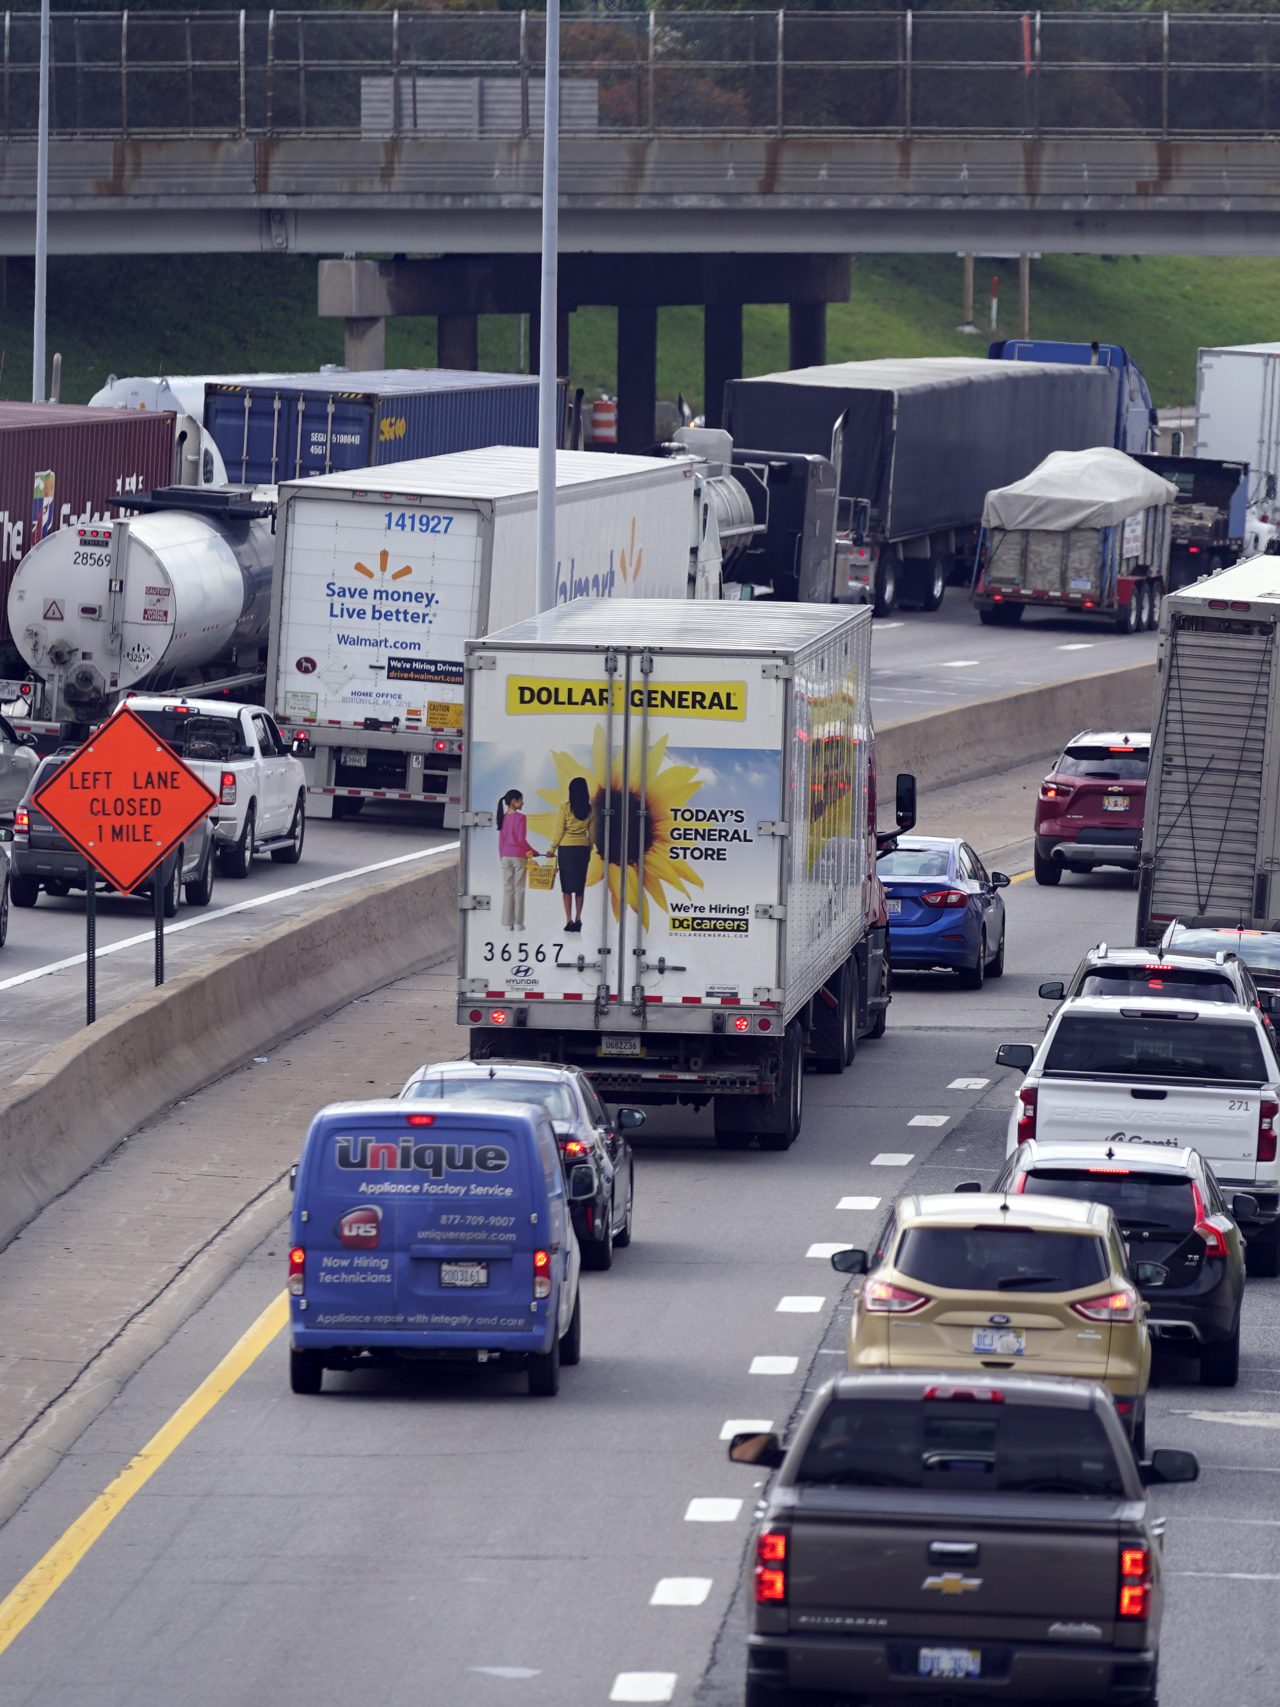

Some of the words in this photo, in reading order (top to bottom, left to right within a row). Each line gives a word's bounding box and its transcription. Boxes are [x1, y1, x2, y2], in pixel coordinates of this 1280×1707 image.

[311, 432, 327, 442] SEGU
[310, 445, 326, 455] 45G1
[384, 511, 454, 535] 141927
[73, 551, 111, 567] 28569
[555, 549, 616, 606] almart
[146, 588, 170, 596] CAUTION
[326, 581, 369, 600] Save
[373, 588, 440, 609] money.
[329, 603, 367, 620] Live
[371, 604, 434, 624] better.
[337, 633, 422, 651] Walmart.com
[129, 653, 147, 663] 3257
[390, 659, 411, 669] We're
[412, 661, 435, 673] Hiring
[437, 664, 464, 674] Drivers
[389, 671, 463, 683] drive4walmart.com
[376, 692, 403, 700] OFFICE
[518, 685, 614, 707] DOLLAR
[630, 689, 738, 711] GENERAL
[69, 772, 112, 790] LEFT
[133, 771, 180, 789] LANE
[90, 798, 162, 816] CLOSED
[670, 808, 745, 823] TODAY'S
[98, 825, 103, 842] 1
[111, 825, 153, 842] MILE
[669, 827, 753, 843] GENERAL
[669, 847, 728, 861] STORE
[670, 903, 705, 914] We're
[708, 903, 750, 917] Hiring!
[671, 918, 691, 931] DG
[692, 918, 748, 931] careers
[483, 942, 564, 964] 36567
[1229, 1100, 1250, 1111] 271
[1052, 1105, 1243, 1129] CHEVROLET
[335, 1137, 510, 1179] Unique
[359, 1182, 420, 1194] Appliance
[423, 1183, 466, 1195] Factory
[470, 1184, 513, 1196] Service
[440, 1215, 516, 1227] 877-709-9007
[417, 1229, 516, 1242] uniquerepair.com
[322, 1257, 350, 1268] Now
[354, 1257, 389, 1269] Hiring
[319, 1272, 391, 1283] Technicians
[317, 1314, 371, 1325] Appliance
[373, 1314, 405, 1326] repair
[408, 1314, 429, 1325] with
[431, 1315, 474, 1327] integrity
[478, 1316, 498, 1326] and
[500, 1317, 525, 1326] care
